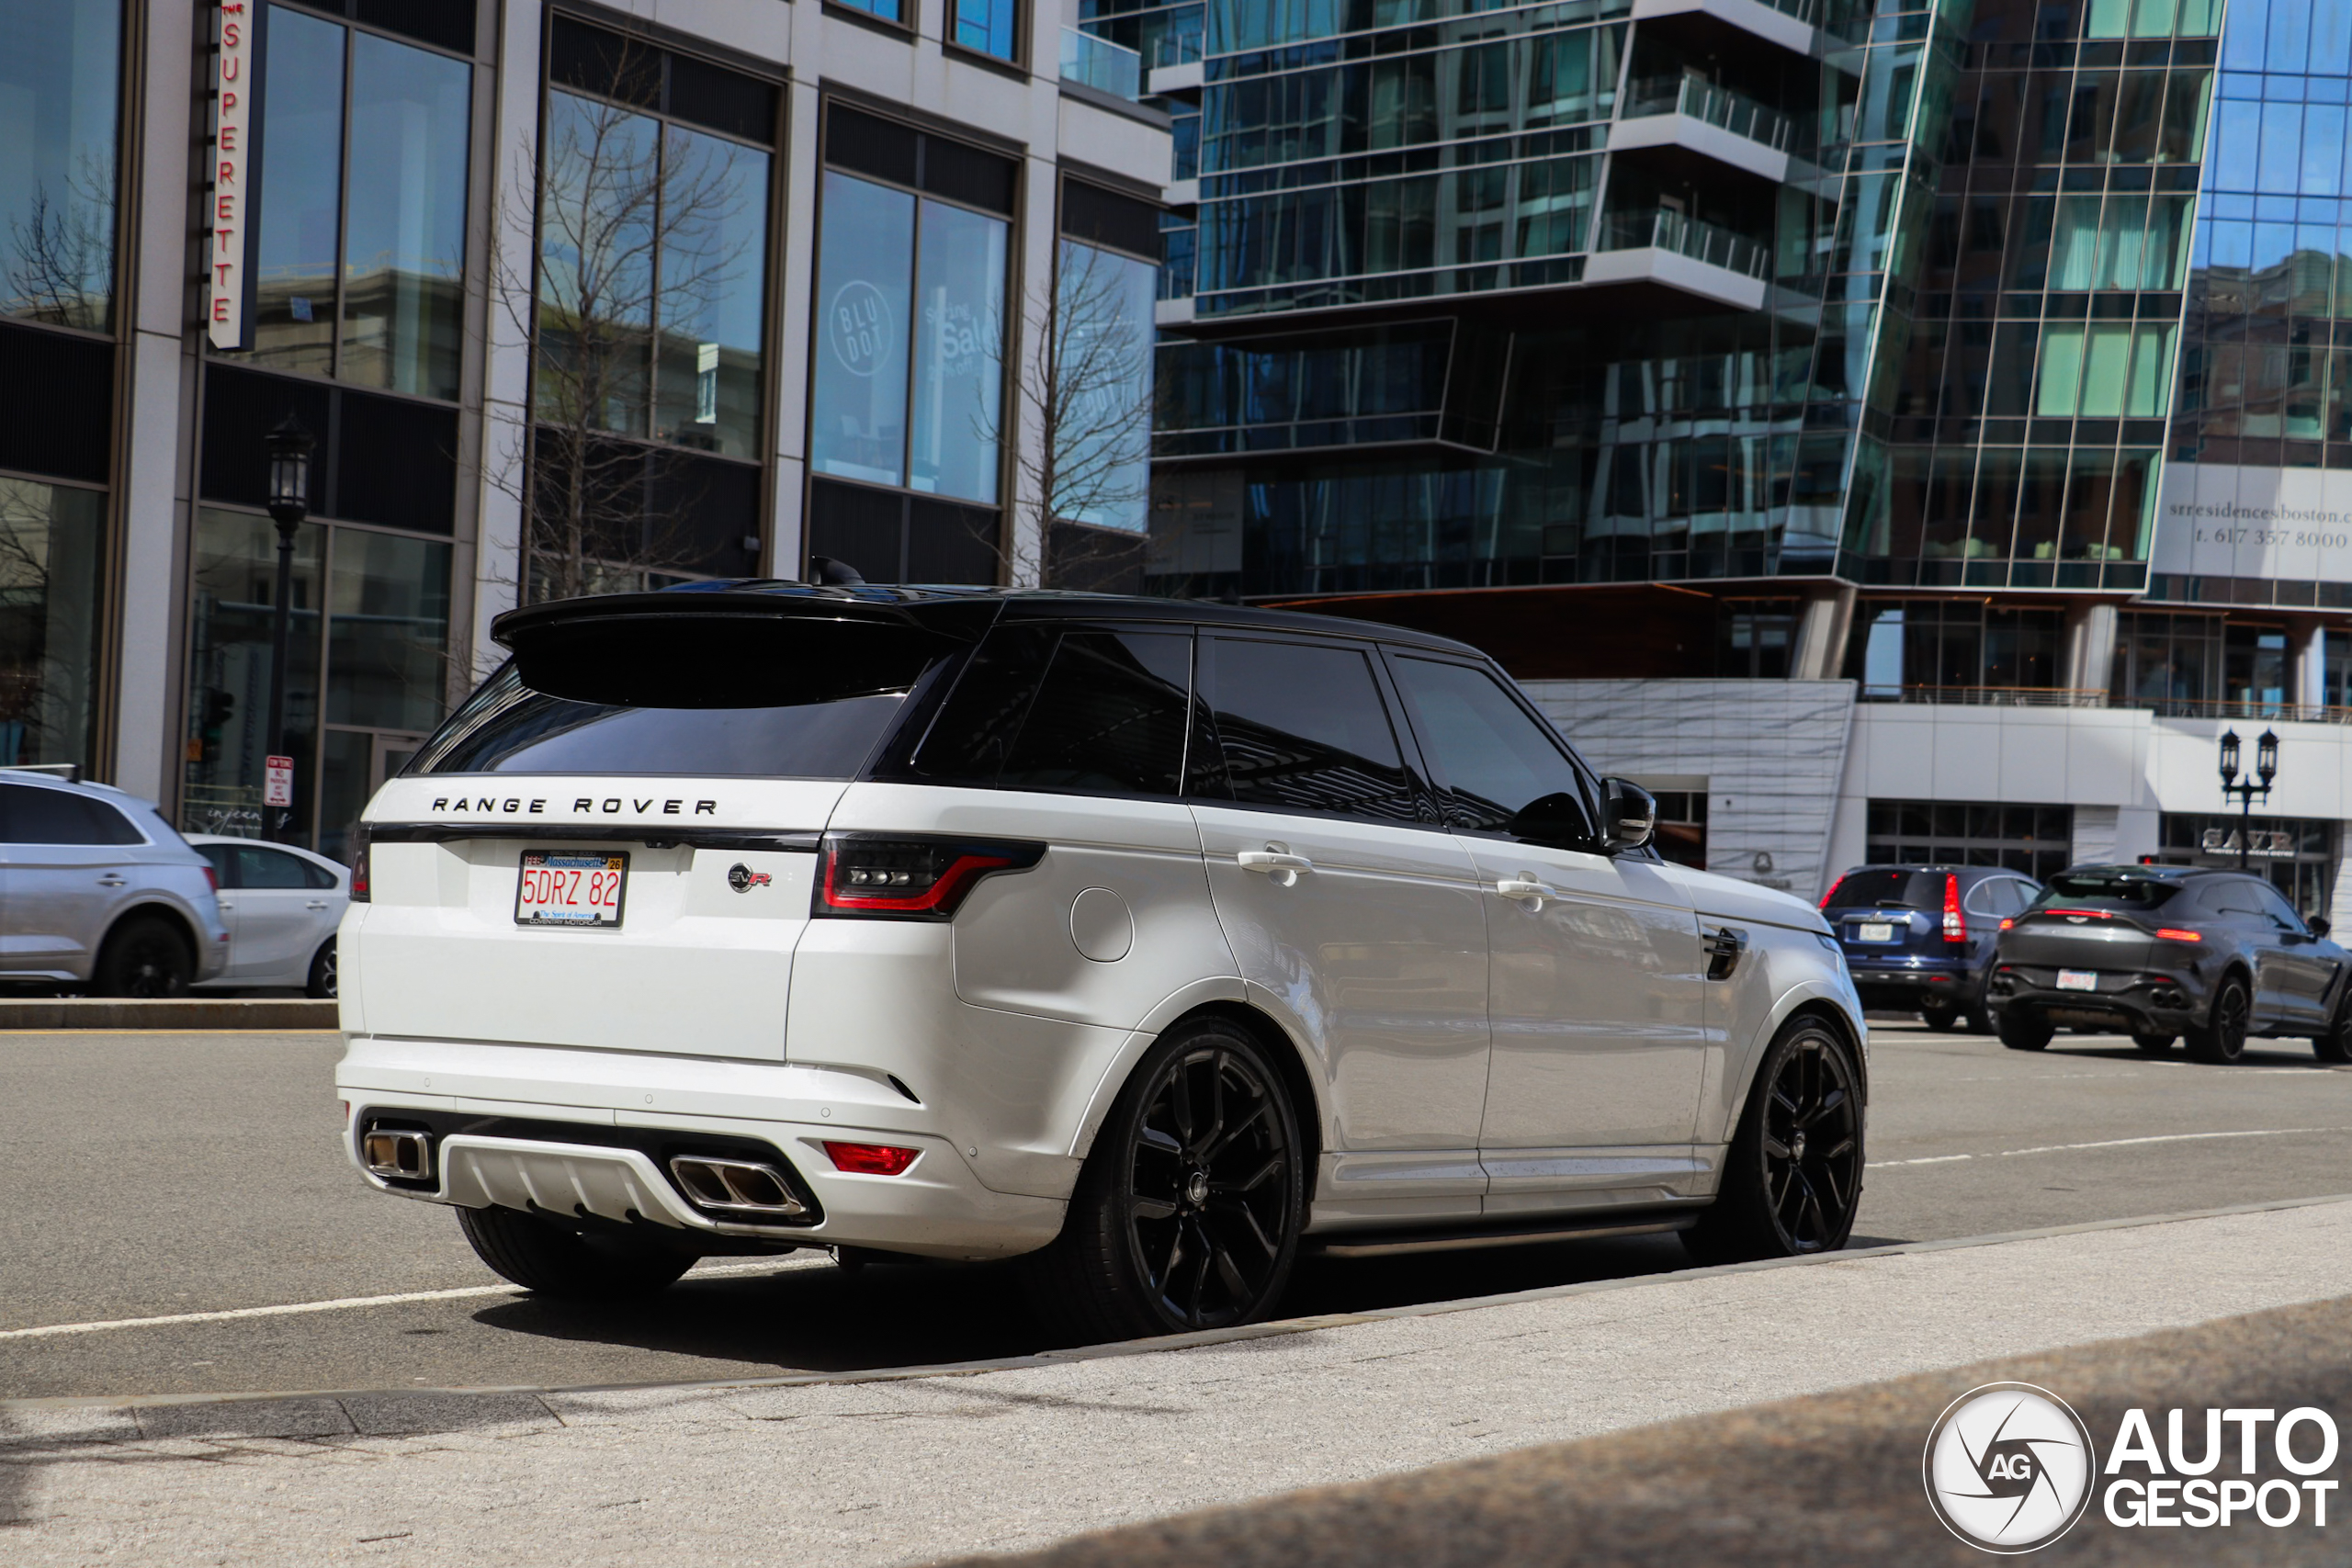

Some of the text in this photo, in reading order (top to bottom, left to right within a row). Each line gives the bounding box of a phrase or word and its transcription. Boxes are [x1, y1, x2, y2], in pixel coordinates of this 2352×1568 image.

[221, 3, 243, 15] THE
[214, 24, 241, 321] SUPERETTE
[839, 296, 877, 333] BLU
[846, 324, 882, 363] DOT
[2214, 528, 2248, 544] 617
[2254, 529, 2290, 546] 357
[2295, 531, 2347, 549] 8000
[432, 797, 718, 815] RANGE ROVER
[526, 856, 620, 869] FEB Massachusetts 26
[523, 870, 619, 906] 5DRZ 82
[729, 871, 772, 886] SVR
[540, 909, 550, 918] The
[551, 910, 566, 919] Spirit
